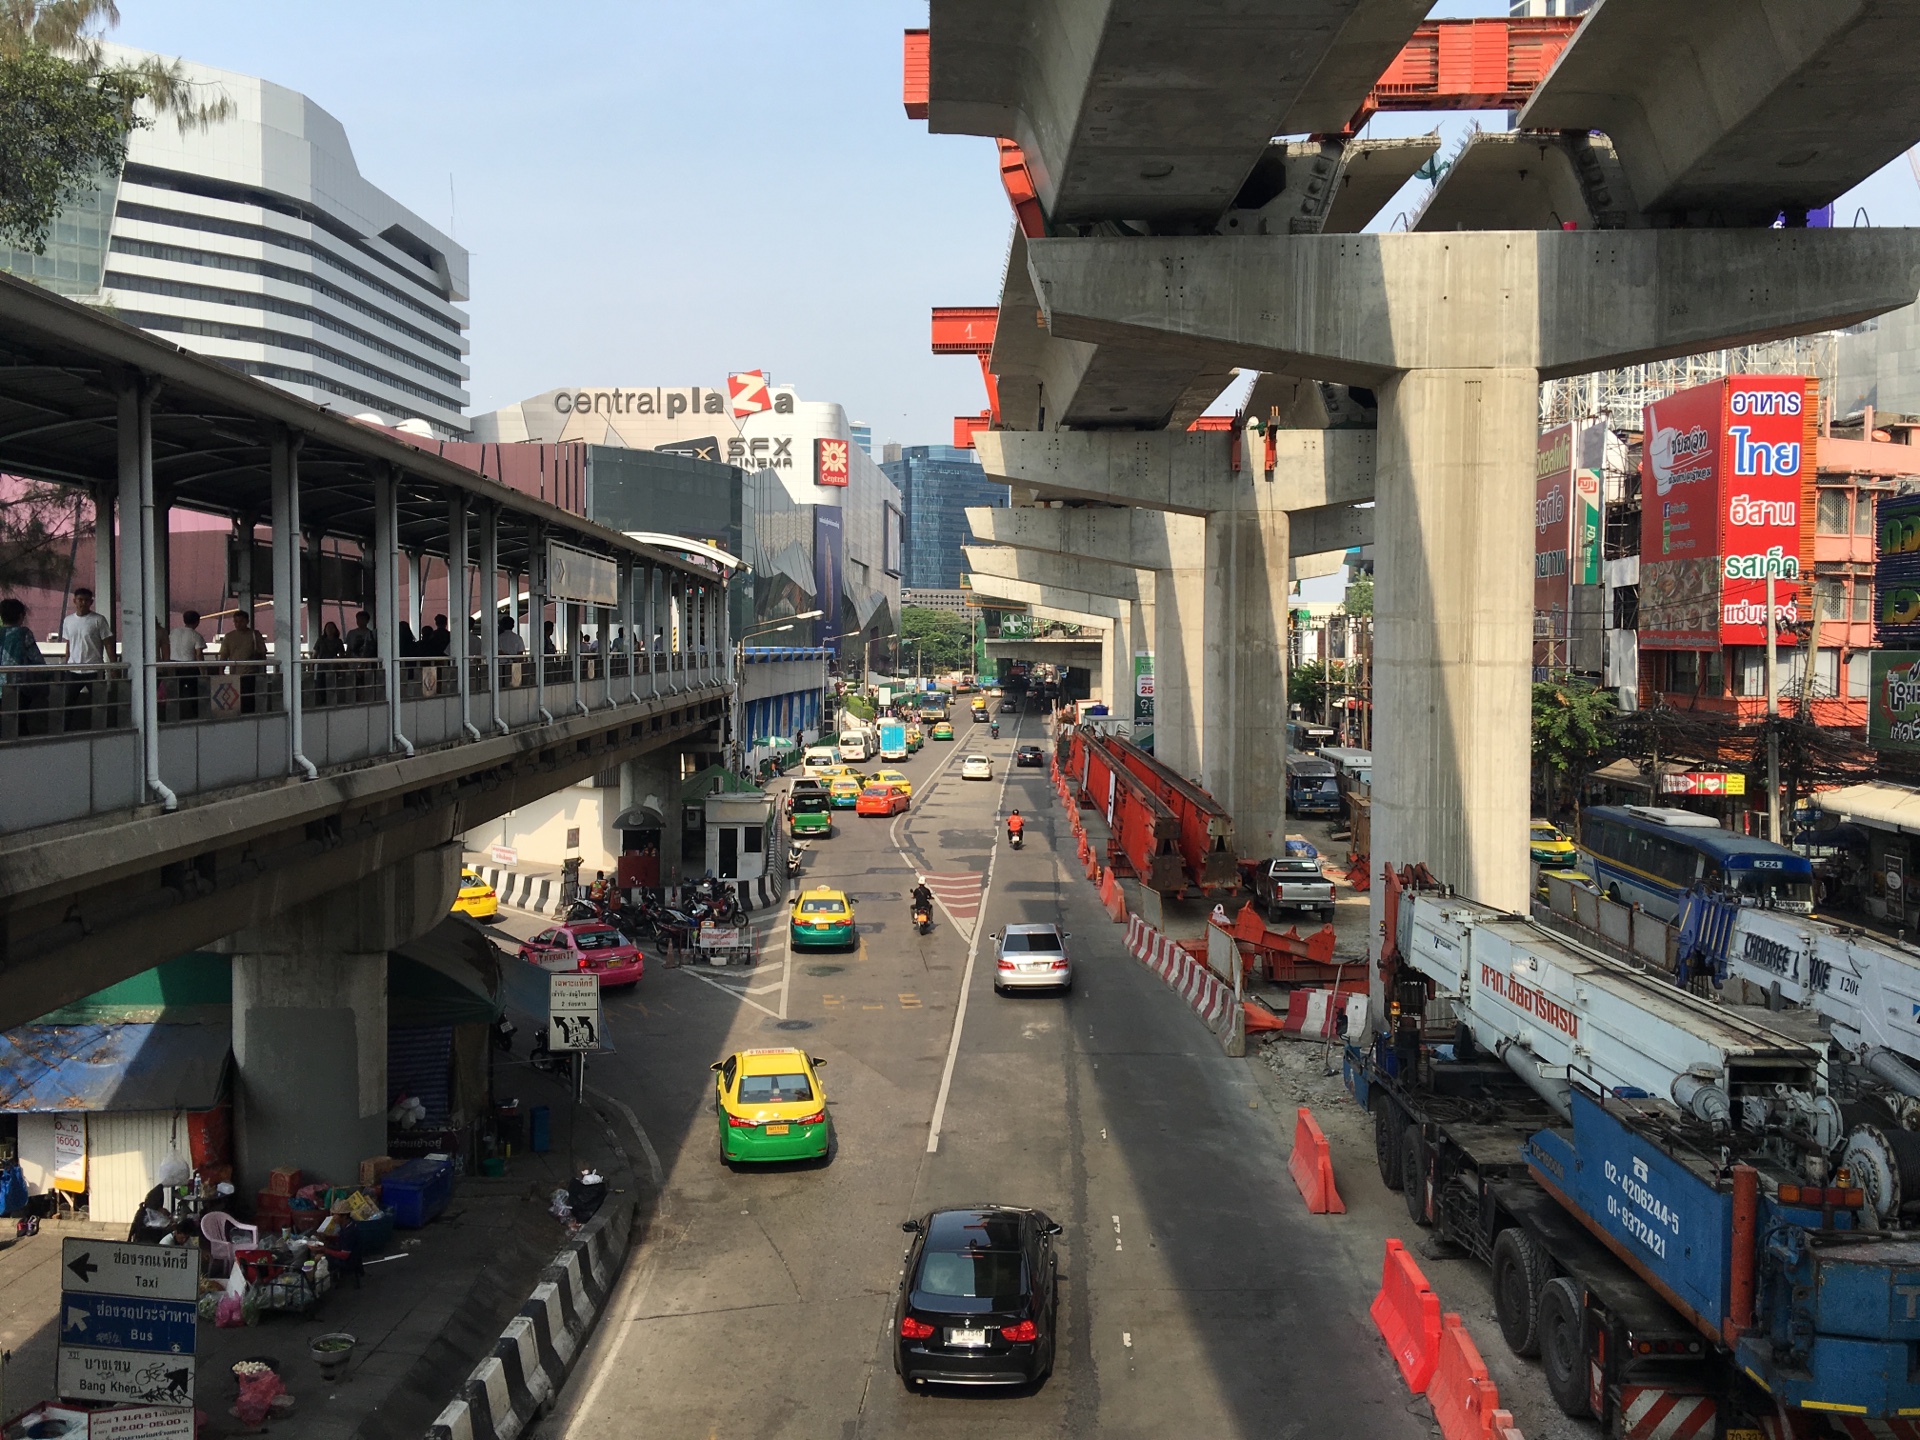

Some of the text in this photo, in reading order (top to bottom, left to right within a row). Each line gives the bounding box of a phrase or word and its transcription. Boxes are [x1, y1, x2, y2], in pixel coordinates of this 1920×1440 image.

[1732, 391, 1801, 415] อาหาร
[727, 437, 793, 457] SFX
[1730, 428, 1800, 476] ไทย
[821, 472, 847, 484] Central
[1730, 495, 1796, 526] อีสาน
[1758, 861, 1779, 869] 524
[1839, 976, 1860, 996] 120t
[113, 1248, 189, 1270] ช่องรถแท็กซี่
[135, 1275, 159, 1289] Taxi
[96, 1300, 196, 1325] ช่องรถประจำทาง
[130, 1328, 153, 1342] Bus
[84, 1357, 131, 1373] บางเขน
[79, 1379, 136, 1394] Bang Khen
